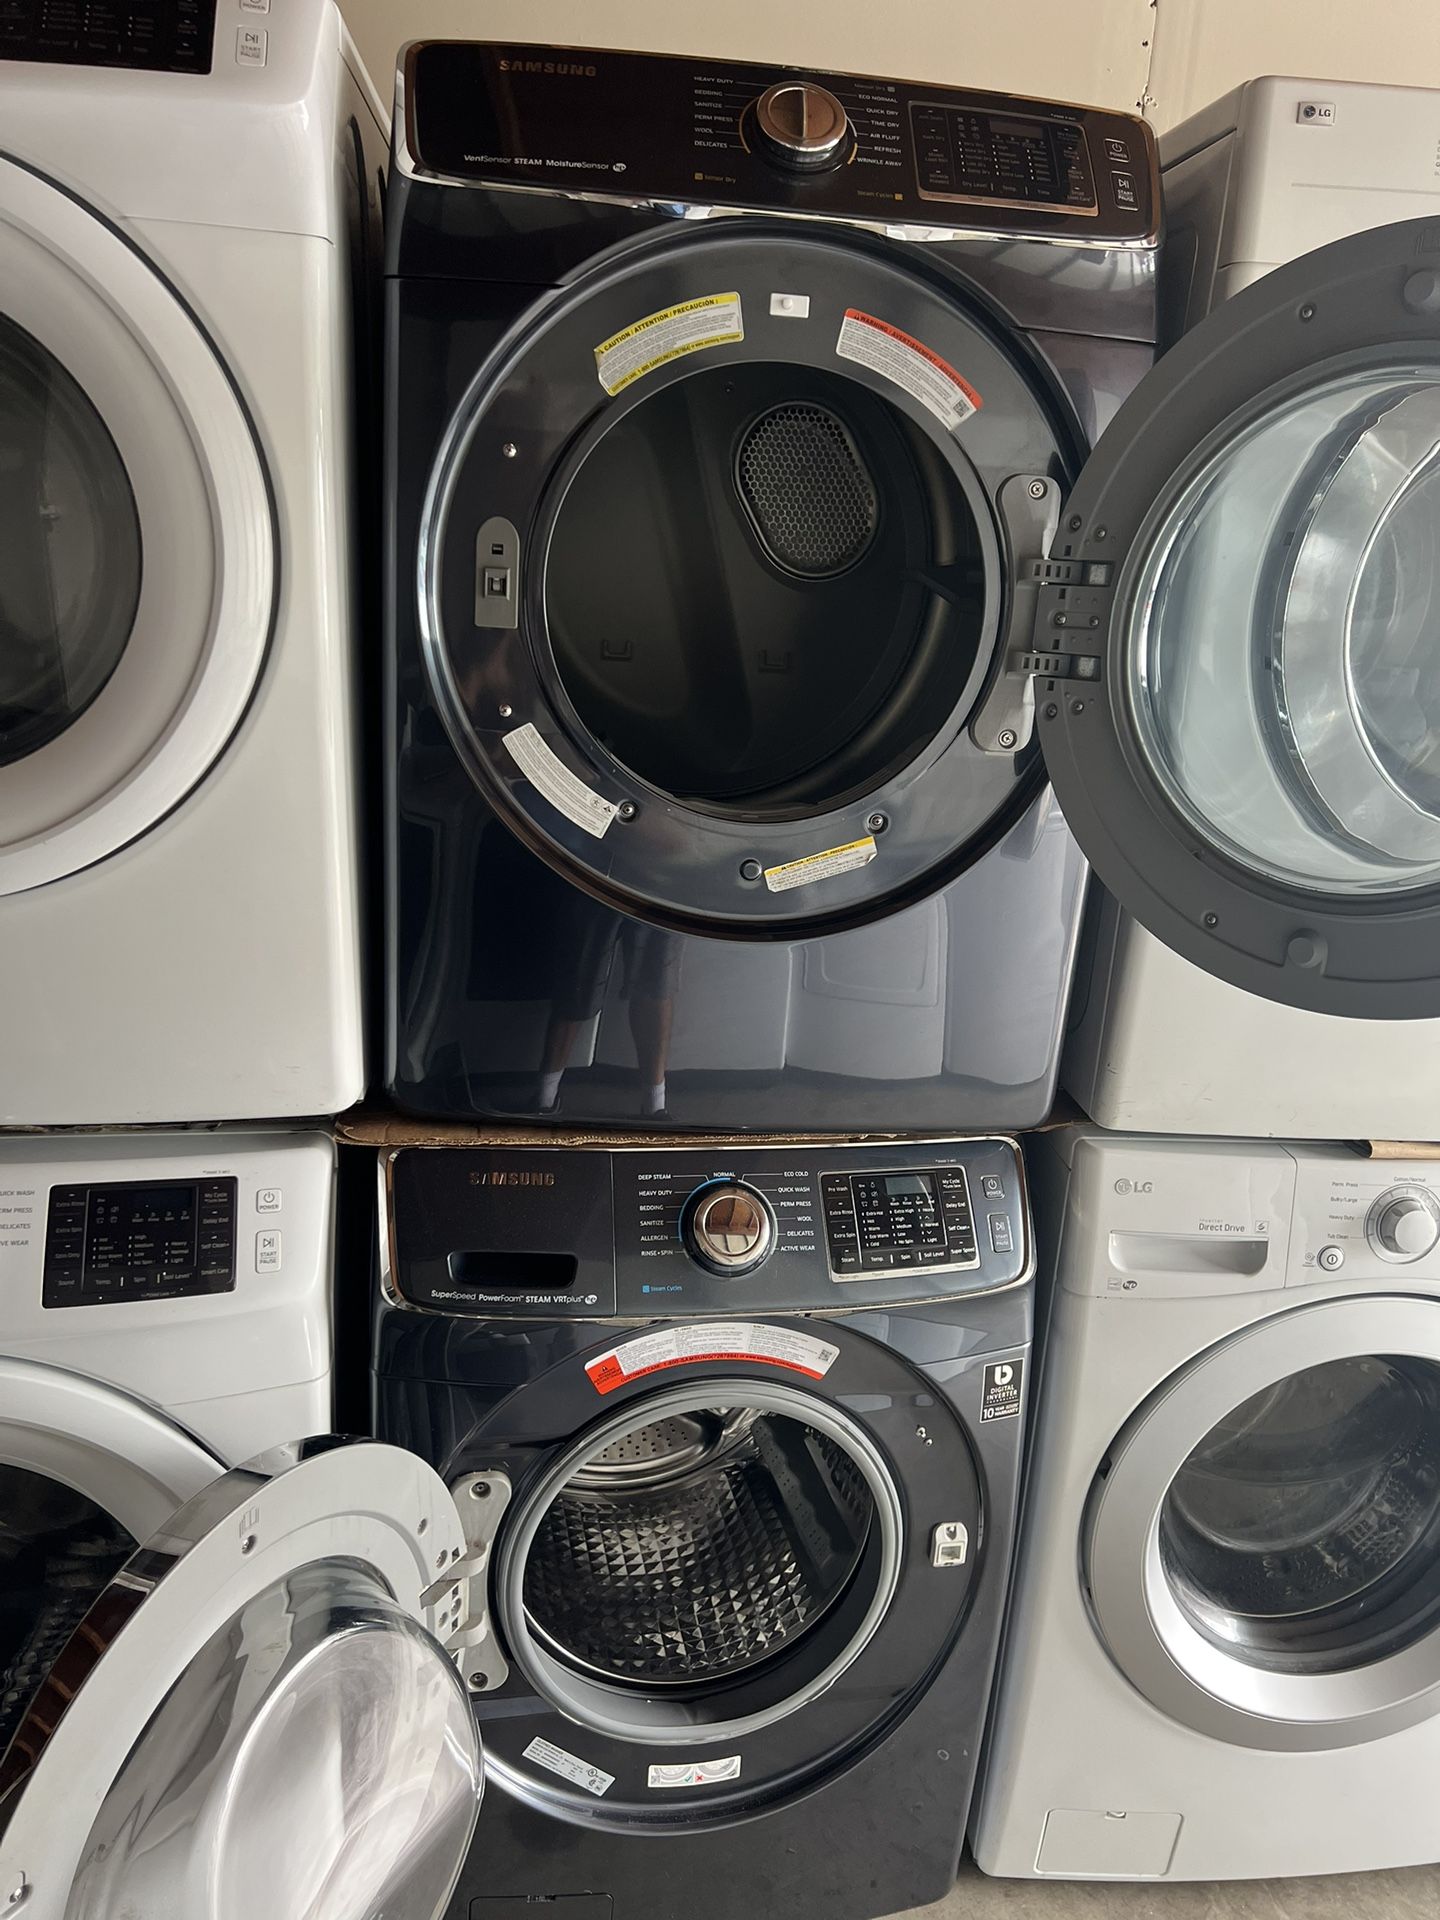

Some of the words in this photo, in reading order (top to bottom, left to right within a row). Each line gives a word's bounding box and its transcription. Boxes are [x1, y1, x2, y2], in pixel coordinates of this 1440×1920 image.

[499, 59, 597, 77] SAMSUNG
[694, 76, 716, 84] HEAVY
[694, 89, 723, 97] BEDDING
[871, 95, 898, 103] NORMAL
[694, 101, 722, 109] SANITIZE
[1318, 108, 1331, 117] LG
[694, 114, 714, 122] PERM
[694, 140, 728, 149] DELICATES
[874, 145, 902, 154] REFRESH
[463, 154, 512, 164] VentSensor
[513, 157, 543, 166] STEAM
[545, 159, 609, 170] MoistureSensor
[857, 157, 883, 166] WRINKLE
[604, 331, 631, 351] CAUTION
[634, 313, 669, 333] ATTENTION
[673, 299, 714, 316] PRECAUCIÓN
[860, 315, 888, 332] WARNING
[891, 330, 937, 363] AVERTISSEMENT
[469, 1172, 555, 1186] SAMSUNG
[1133, 1181, 1153, 1194] LG
[1198, 1223, 1223, 1232] Direct
[1224, 1223, 1245, 1232] Drive
[431, 1290, 476, 1301] SuperSpeed
[525, 1294, 551, 1304] STEAM
[621, 1369, 648, 1383] CUSTOMER
[990, 1384, 1014, 1395] DIGITAL
[986, 1390, 1018, 1401] INVERTER
[983, 1407, 995, 1419] 10
[995, 1408, 1019, 1416] WARRANTY
